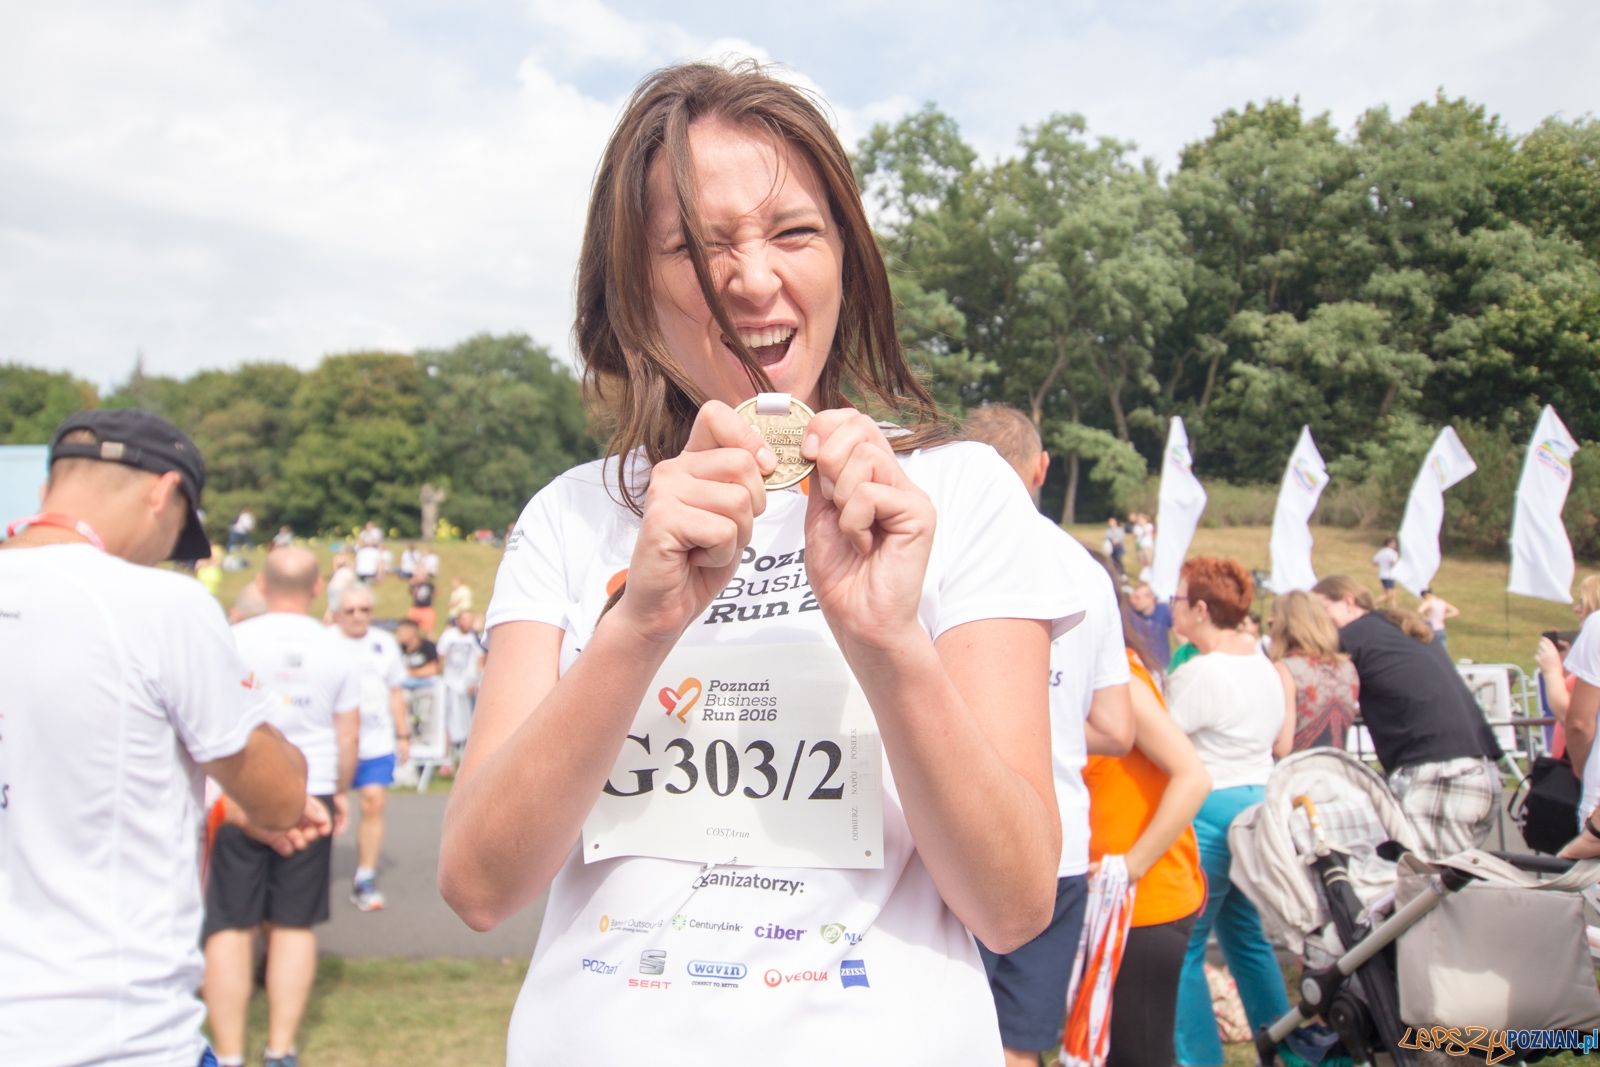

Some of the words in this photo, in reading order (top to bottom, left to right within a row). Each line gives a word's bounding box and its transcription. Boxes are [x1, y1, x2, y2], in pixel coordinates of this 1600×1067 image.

[766, 426, 803, 435] Poland
[714, 568, 809, 600] Busi
[703, 600, 789, 624] Run
[708, 679, 770, 692] Poznań
[704, 693, 777, 706] Business
[702, 708, 735, 721] Run
[738, 709, 777, 721] 2016
[602, 733, 845, 801] G303/2
[850, 770, 858, 795] NAPÓJ
[851, 805, 859, 841] ODBIERZ:
[706, 827, 750, 838] COSTArun
[689, 919, 742, 932] CenturyLink
[754, 923, 806, 941] ciber
[693, 963, 740, 976] wavin
[840, 967, 866, 976] ZEISS
[784, 970, 828, 983] VEOLIA
[628, 978, 672, 989] SEAT
